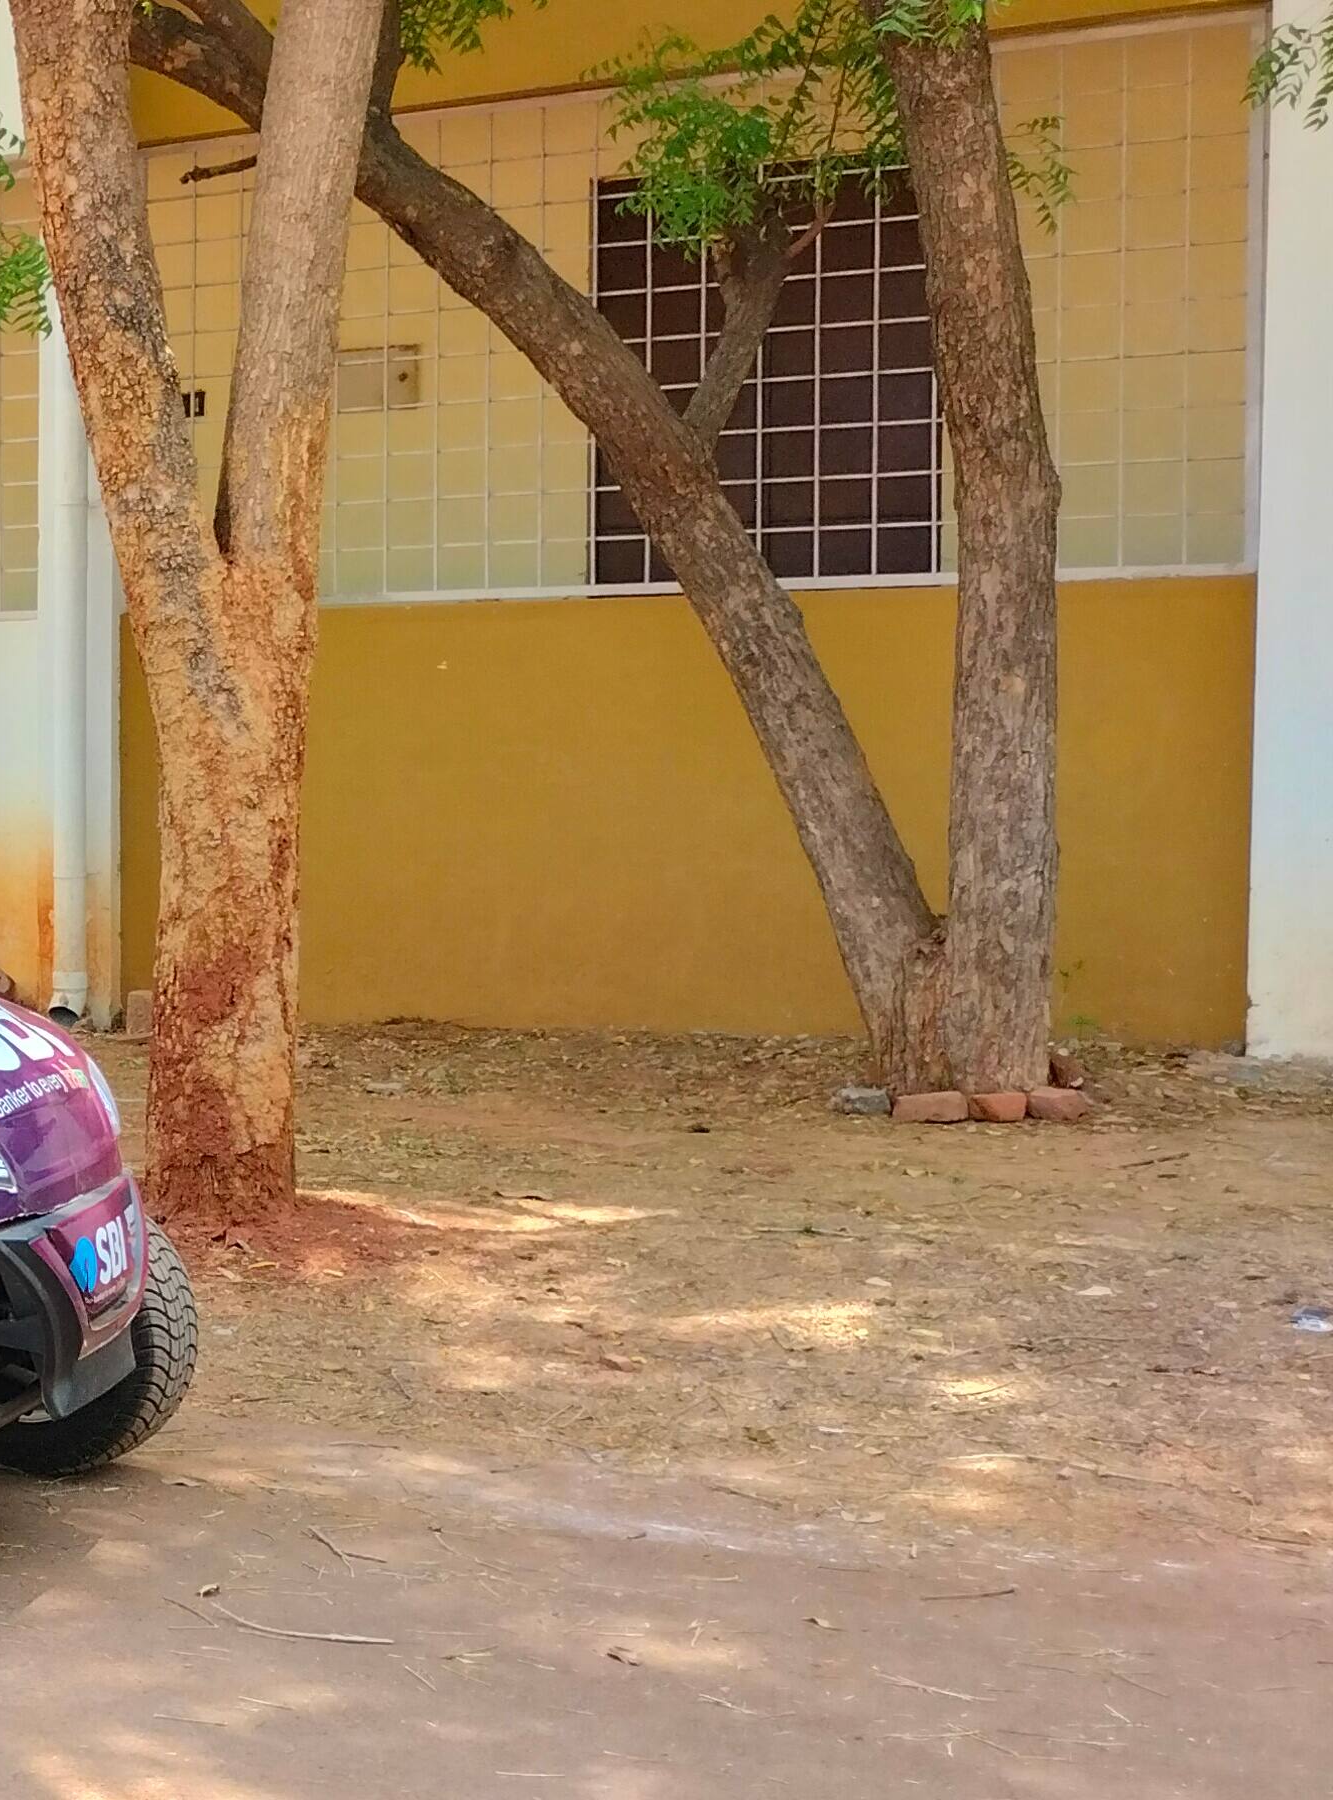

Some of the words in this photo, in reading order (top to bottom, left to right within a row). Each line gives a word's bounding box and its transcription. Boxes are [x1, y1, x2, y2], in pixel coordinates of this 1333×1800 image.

[24, 1080, 44, 1099] to
[38, 1073, 69, 1093] every
[95, 1215, 128, 1285] SBI
